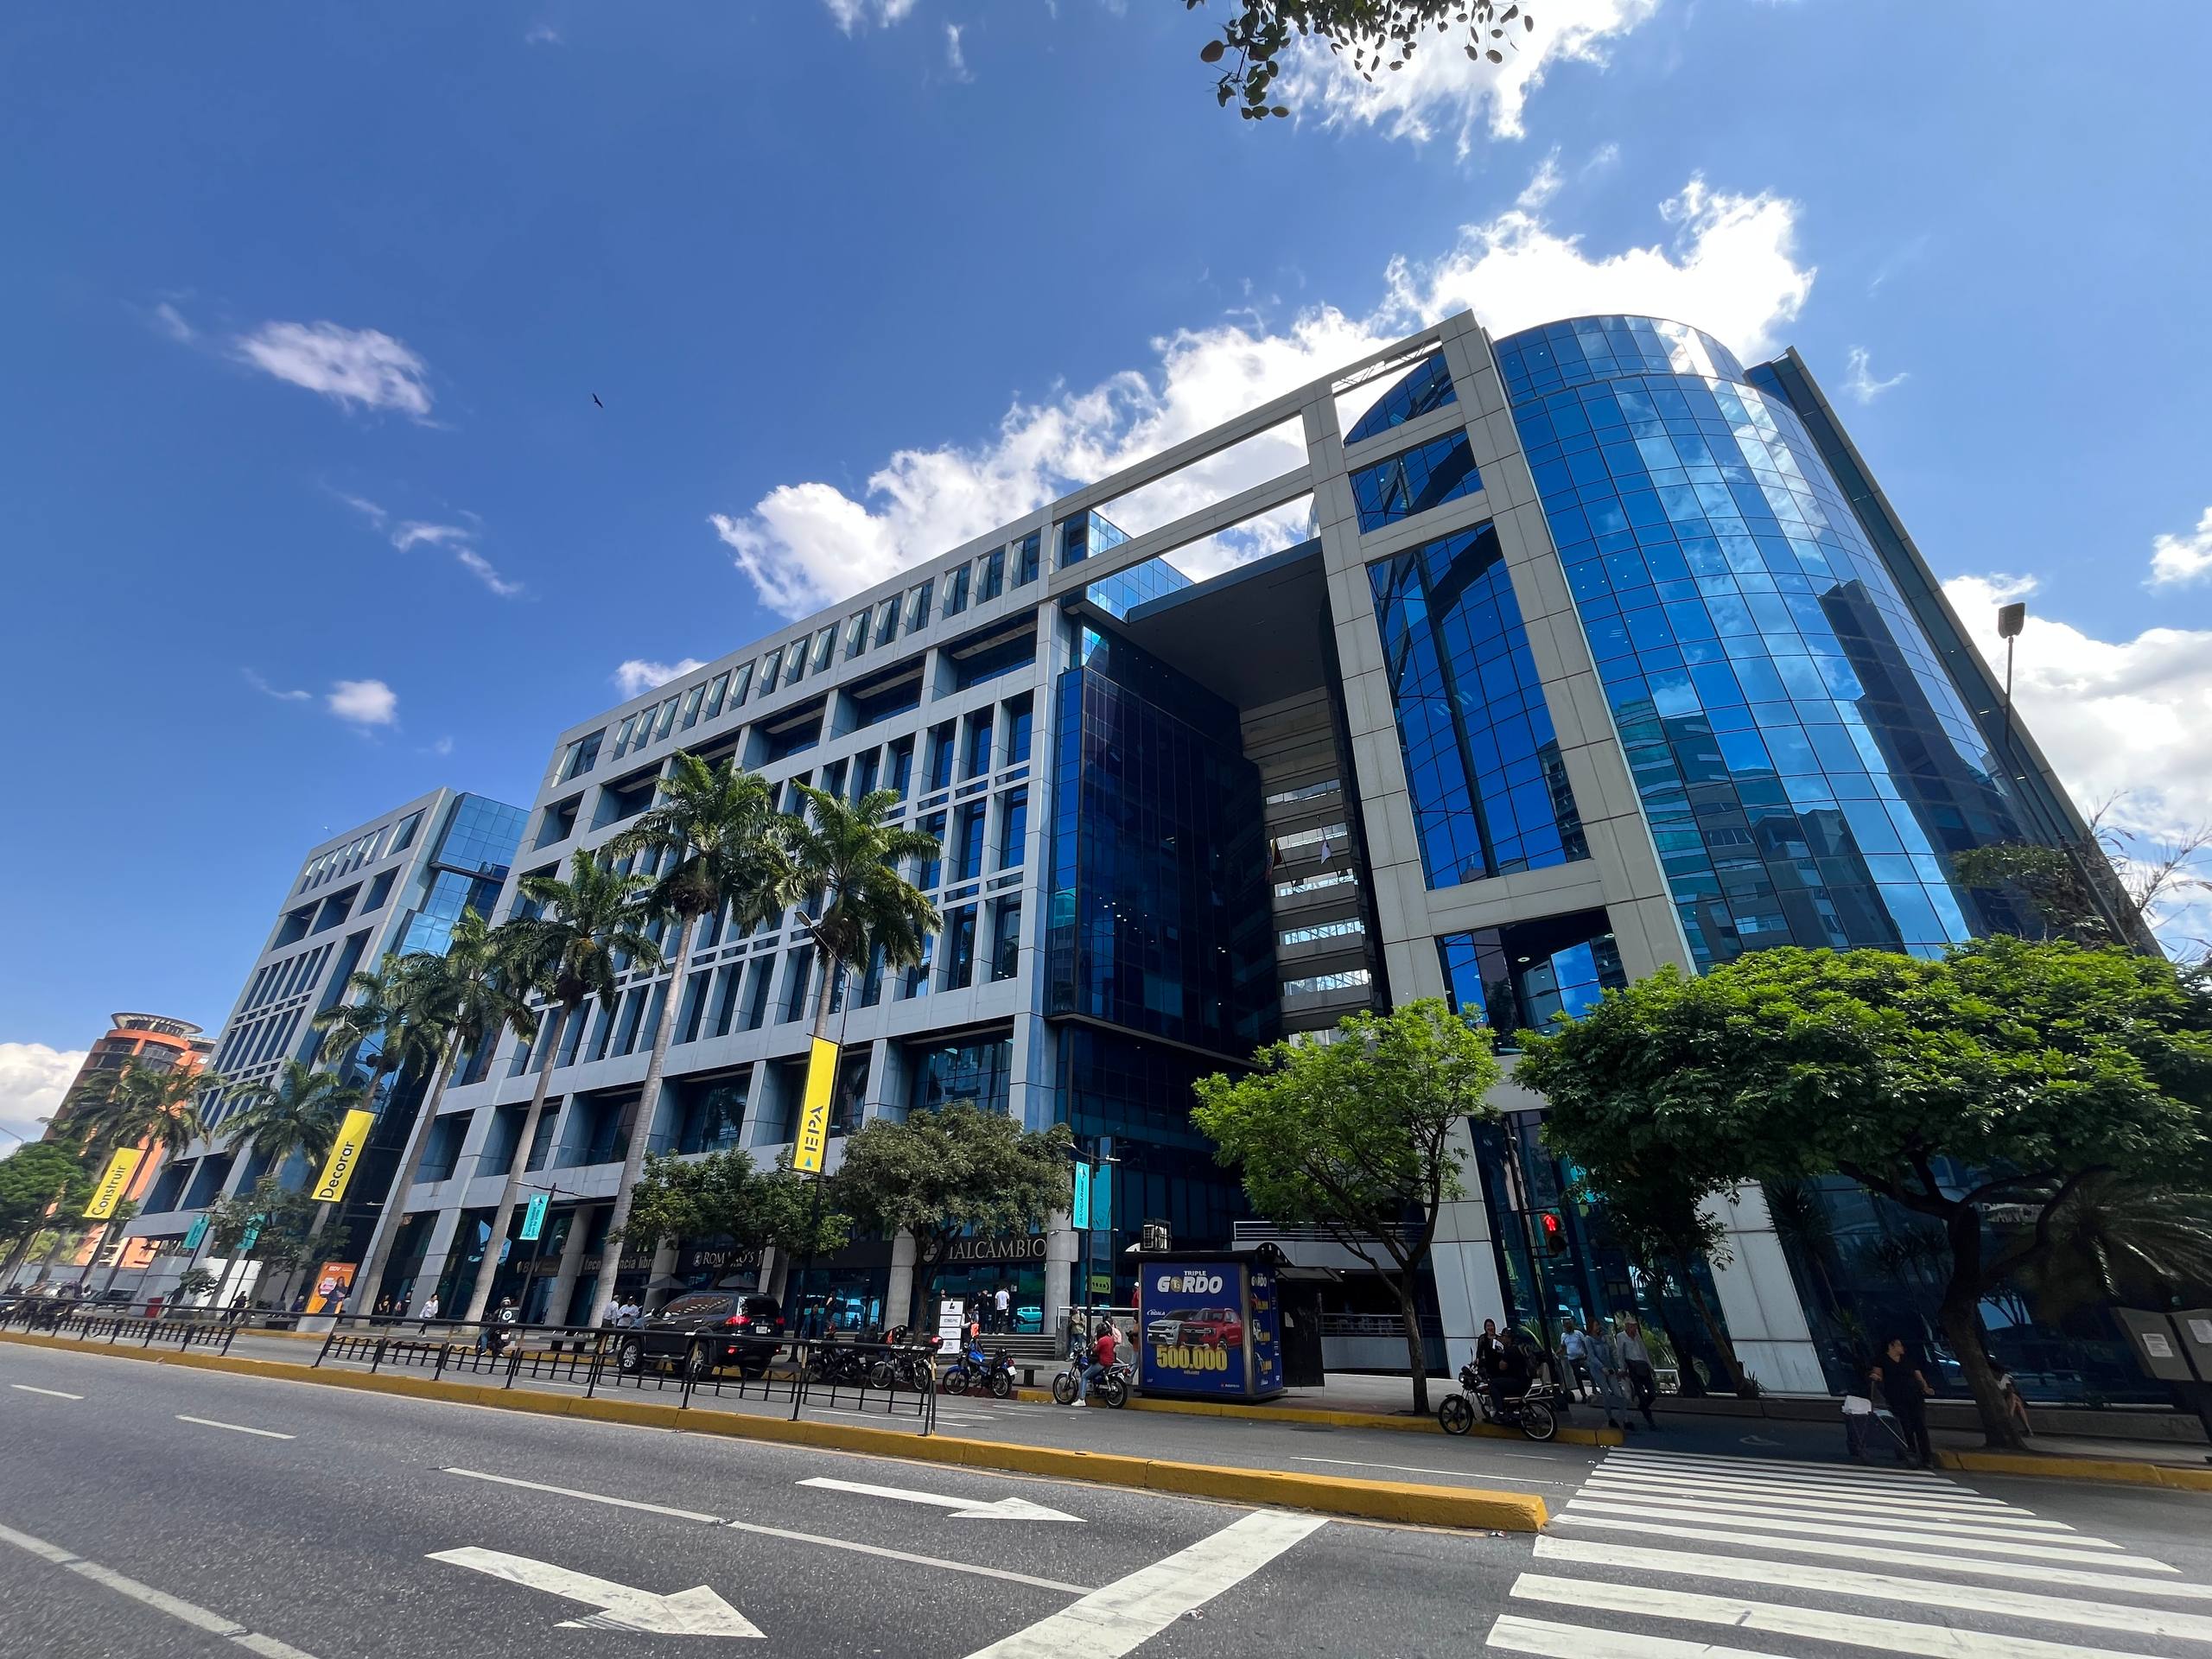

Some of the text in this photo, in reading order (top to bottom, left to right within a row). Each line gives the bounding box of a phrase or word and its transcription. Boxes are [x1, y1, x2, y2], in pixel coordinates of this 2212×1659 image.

[804, 1106, 824, 1153] EPA
[91, 1165, 127, 1216] Construir
[319, 1141, 355, 1198] Decorar
[1157, 1275, 1224, 1294] GORDO
[1156, 1344, 1228, 1371] 500.000
